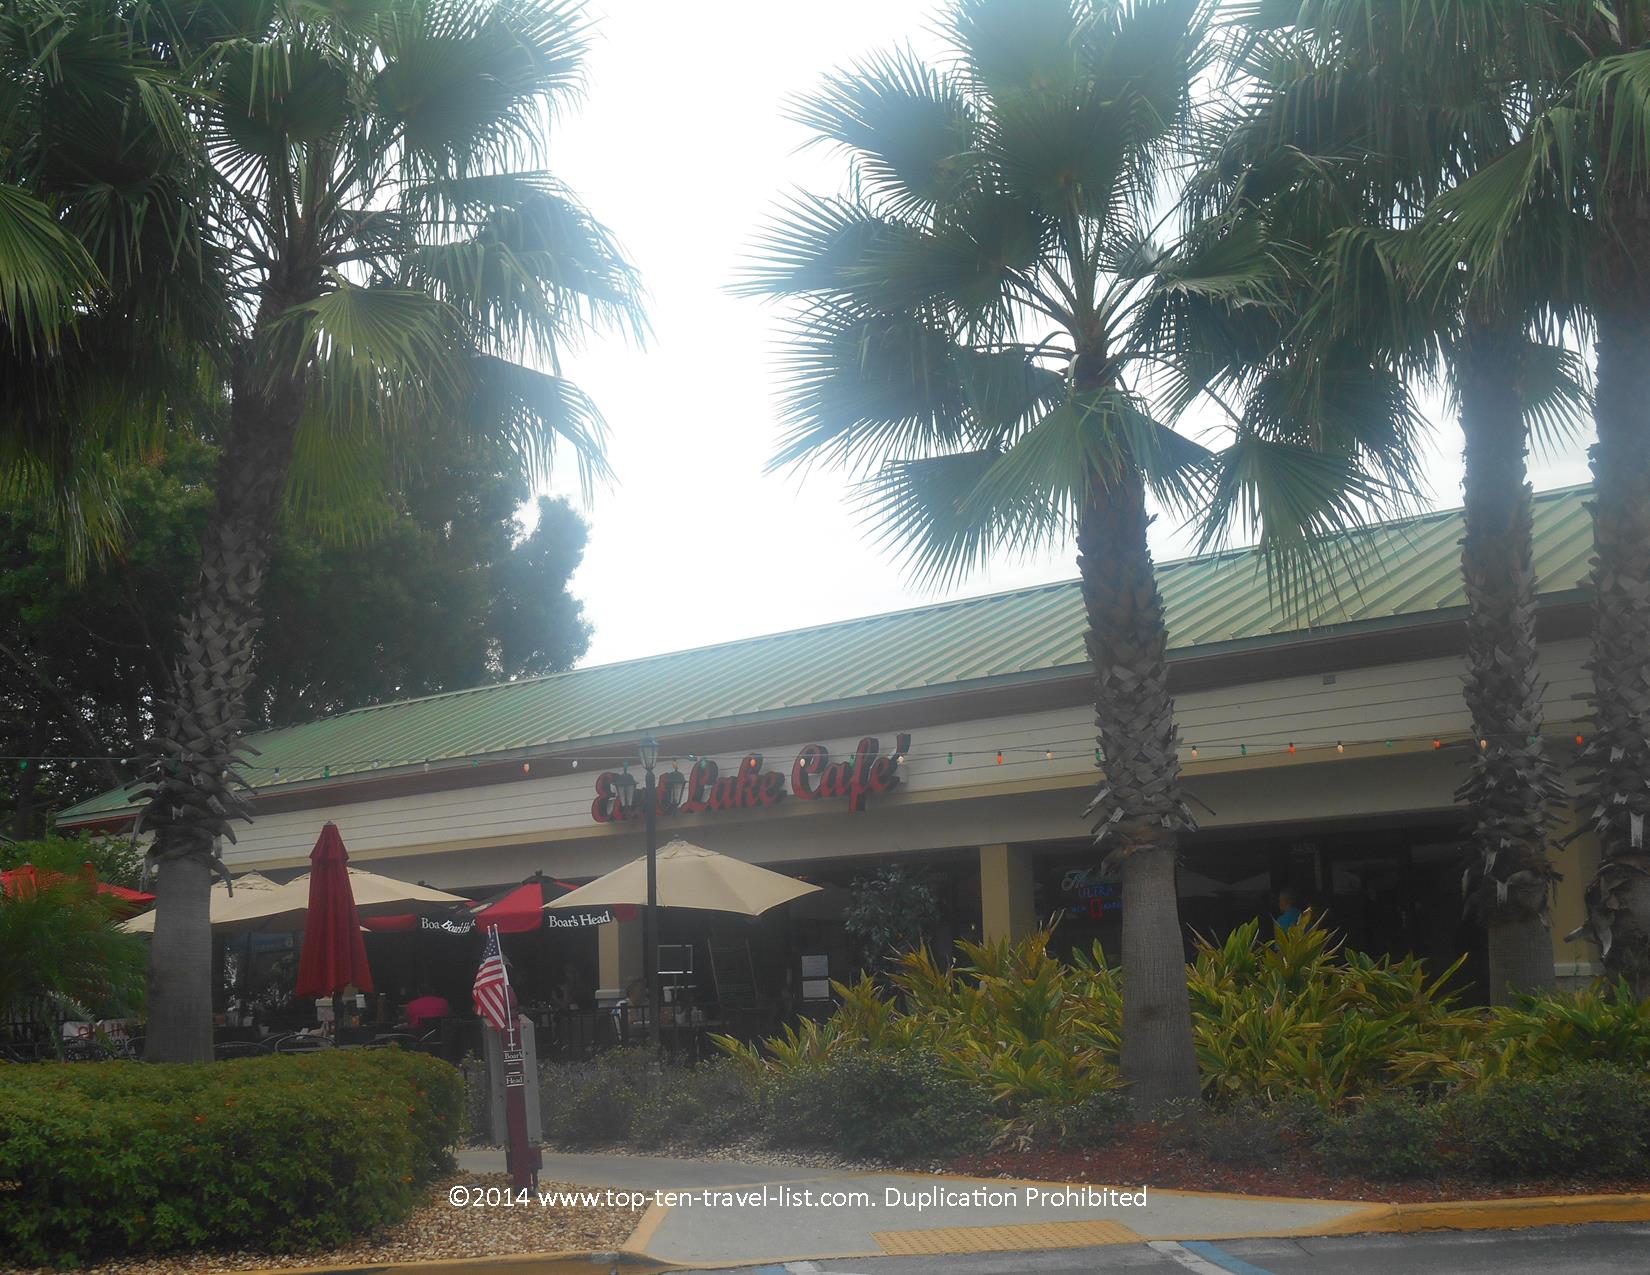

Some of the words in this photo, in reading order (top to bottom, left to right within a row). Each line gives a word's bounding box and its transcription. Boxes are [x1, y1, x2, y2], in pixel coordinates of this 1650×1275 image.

[680, 752, 786, 813] Lake
[549, 914, 579, 928] Boar's
[579, 910, 611, 927] Head
[506, 1076, 523, 1085] Head
